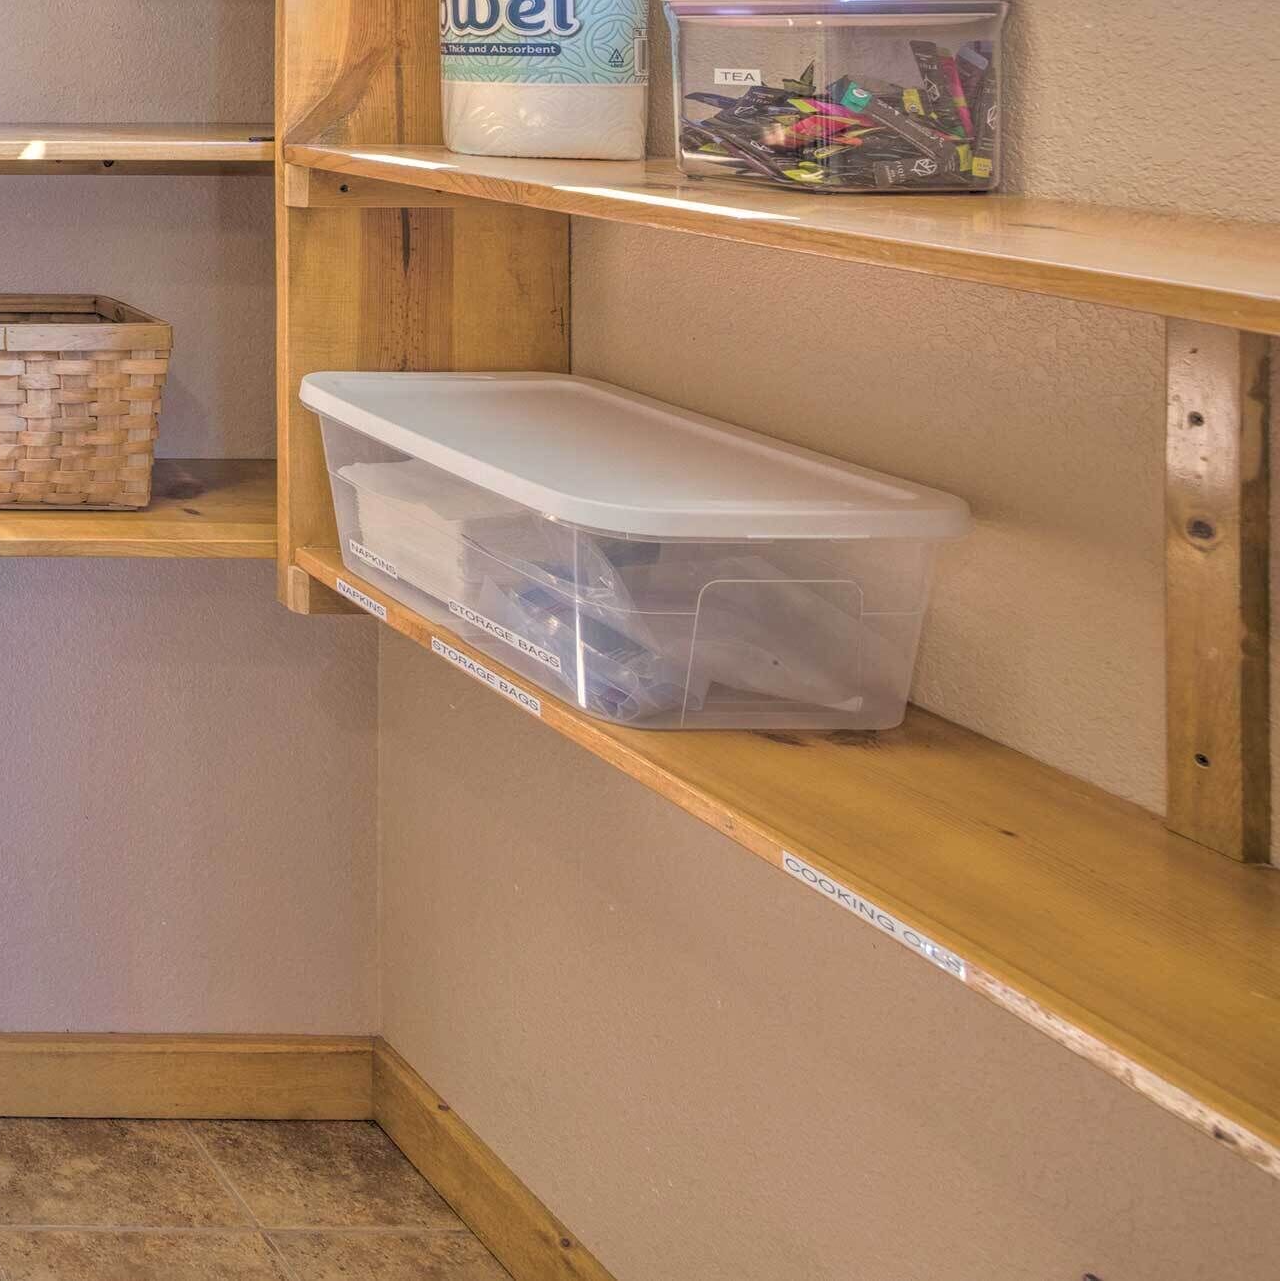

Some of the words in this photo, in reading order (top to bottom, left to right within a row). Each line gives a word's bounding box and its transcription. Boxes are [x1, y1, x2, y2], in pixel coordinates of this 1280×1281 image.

[468, 44, 487, 53] and
[490, 44, 557, 55] Absorbent
[720, 71, 756, 82] TEA
[351, 542, 397, 575] NAPKINS
[339, 582, 385, 616] NAPKINS
[449, 601, 514, 640] STORAGE
[518, 639, 560, 668] BAGS
[432, 640, 496, 684] STORAGE
[499, 681, 539, 711] BAGS
[785, 858, 896, 932] COOKING
